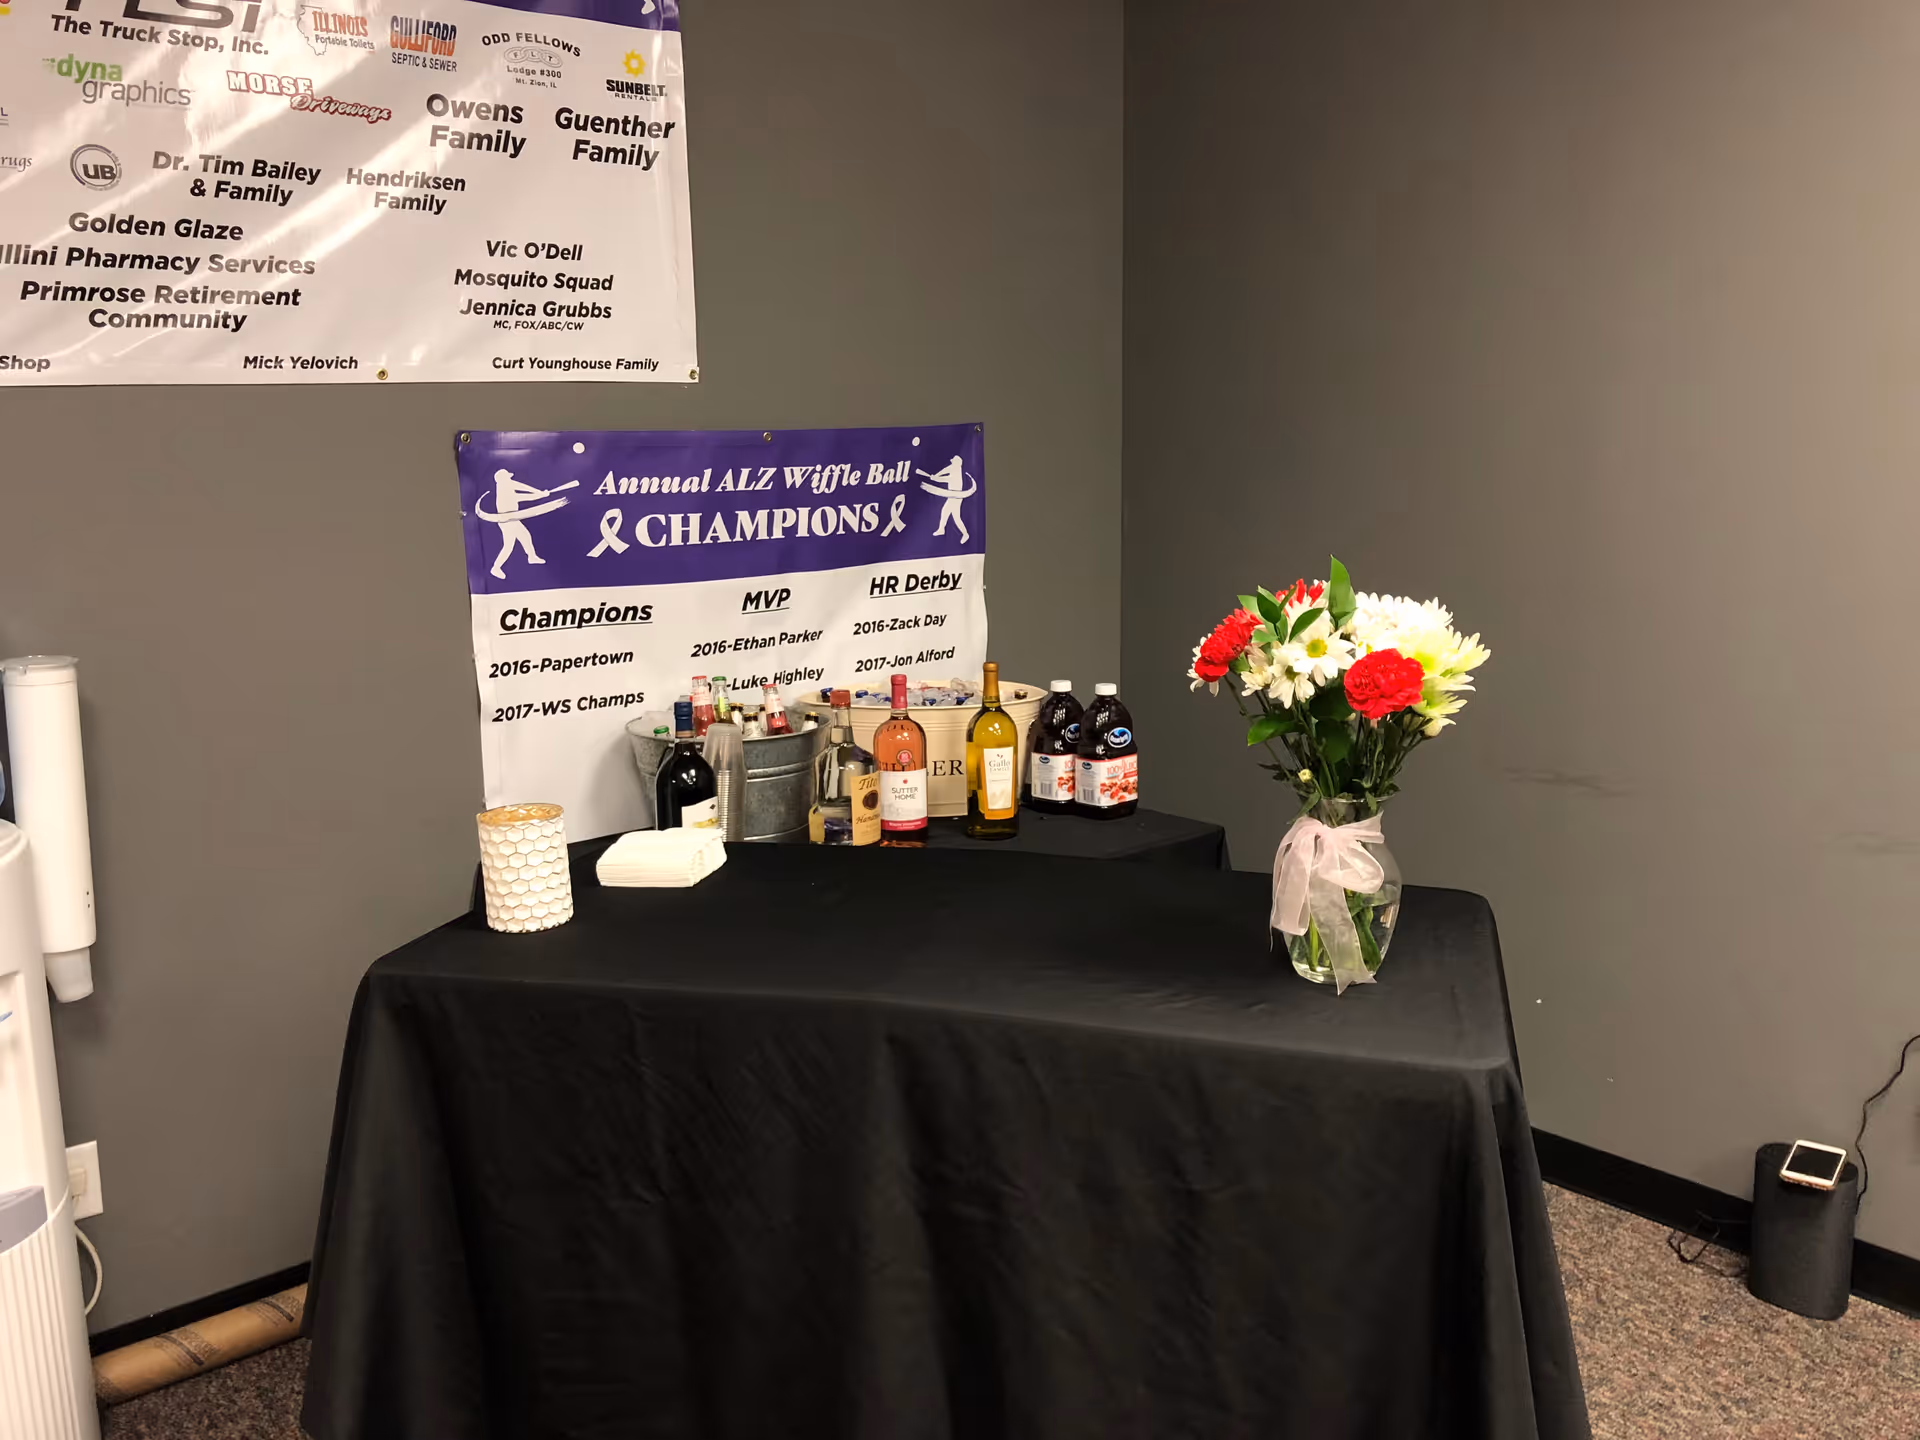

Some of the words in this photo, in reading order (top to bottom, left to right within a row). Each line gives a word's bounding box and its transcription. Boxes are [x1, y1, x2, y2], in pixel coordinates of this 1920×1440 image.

[51, 14, 91, 35] The
[100, 20, 162, 44] Truck
[167, 29, 224, 53] Stop,
[232, 36, 269, 55] Inc.
[312, 10, 368, 37] ILLINOIS
[390, 15, 457, 57] GULLIFORD
[315, 34, 347, 47] Portable
[349, 38, 375, 50] Toilets
[481, 32, 511, 46] ODD
[516, 32, 581, 57] FELLOWS
[57, 53, 122, 83] dyna
[391, 52, 420, 67] SEPTIC
[421, 57, 427, 68] &
[429, 58, 457, 73] SEWER
[507, 65, 537, 76] Lodge
[539, 68, 562, 79] #300
[82, 79, 191, 106] graphics
[226, 70, 313, 97] MORSE
[606, 79, 666, 97] SUNBELT
[290, 94, 392, 124] Driveways
[426, 93, 524, 125] Owens
[554, 106, 675, 139] Guenther
[430, 124, 527, 159] Family
[152, 151, 189, 171] Dr.
[199, 154, 244, 175] Tim
[251, 158, 322, 185] Bailey
[572, 139, 660, 172] Family
[82, 164, 116, 179] UB
[346, 168, 466, 192] Hendriksen
[190, 179, 207, 197] &
[214, 180, 293, 207] Family
[374, 192, 447, 216] Family
[68, 212, 165, 237] Golden
[174, 218, 244, 241] Glaze
[65, 247, 200, 275] Pharmacy
[208, 253, 316, 275] Services
[486, 240, 518, 258] Vic
[524, 242, 583, 261] O'Dell
[454, 268, 548, 290] Mosquito
[553, 273, 614, 292] Squad
[20, 281, 146, 304] Primrose
[154, 285, 302, 306] Retirement
[89, 308, 247, 333] Community
[460, 299, 536, 317] Jennica
[542, 300, 612, 319] Grubbs
[493, 320, 511, 331] MC,
[514, 320, 584, 331] FOX/ABC/CW
[0, 355, 51, 372] Shop
[243, 356, 285, 370] Mick
[289, 356, 359, 371] Yelovich
[492, 357, 524, 370] Curt
[528, 357, 612, 372] Younghouse
[615, 358, 659, 372] Family
[593, 468, 712, 495] Annual
[716, 467, 777, 492] ALZ
[784, 464, 861, 494] Wiffle
[865, 460, 911, 485] Ball
[635, 502, 879, 548] CHAMPIONS
[870, 576, 899, 595] HR
[904, 570, 963, 592] Derby
[742, 588, 791, 611] MVP
[500, 602, 653, 632] Champions
[853, 615, 920, 636] 2016-Zack
[924, 613, 947, 628] Day
[690, 636, 776, 657] 2016-Ethan
[779, 628, 823, 645] Parker
[489, 650, 634, 678] 2016-Papertown
[855, 653, 913, 673] 2017-Jon
[916, 646, 955, 664] Alford
[773, 667, 825, 687] Highley
[492, 699, 571, 723] 2017-WS
[577, 691, 645, 712] Champs
[930, 759, 965, 777] ER
